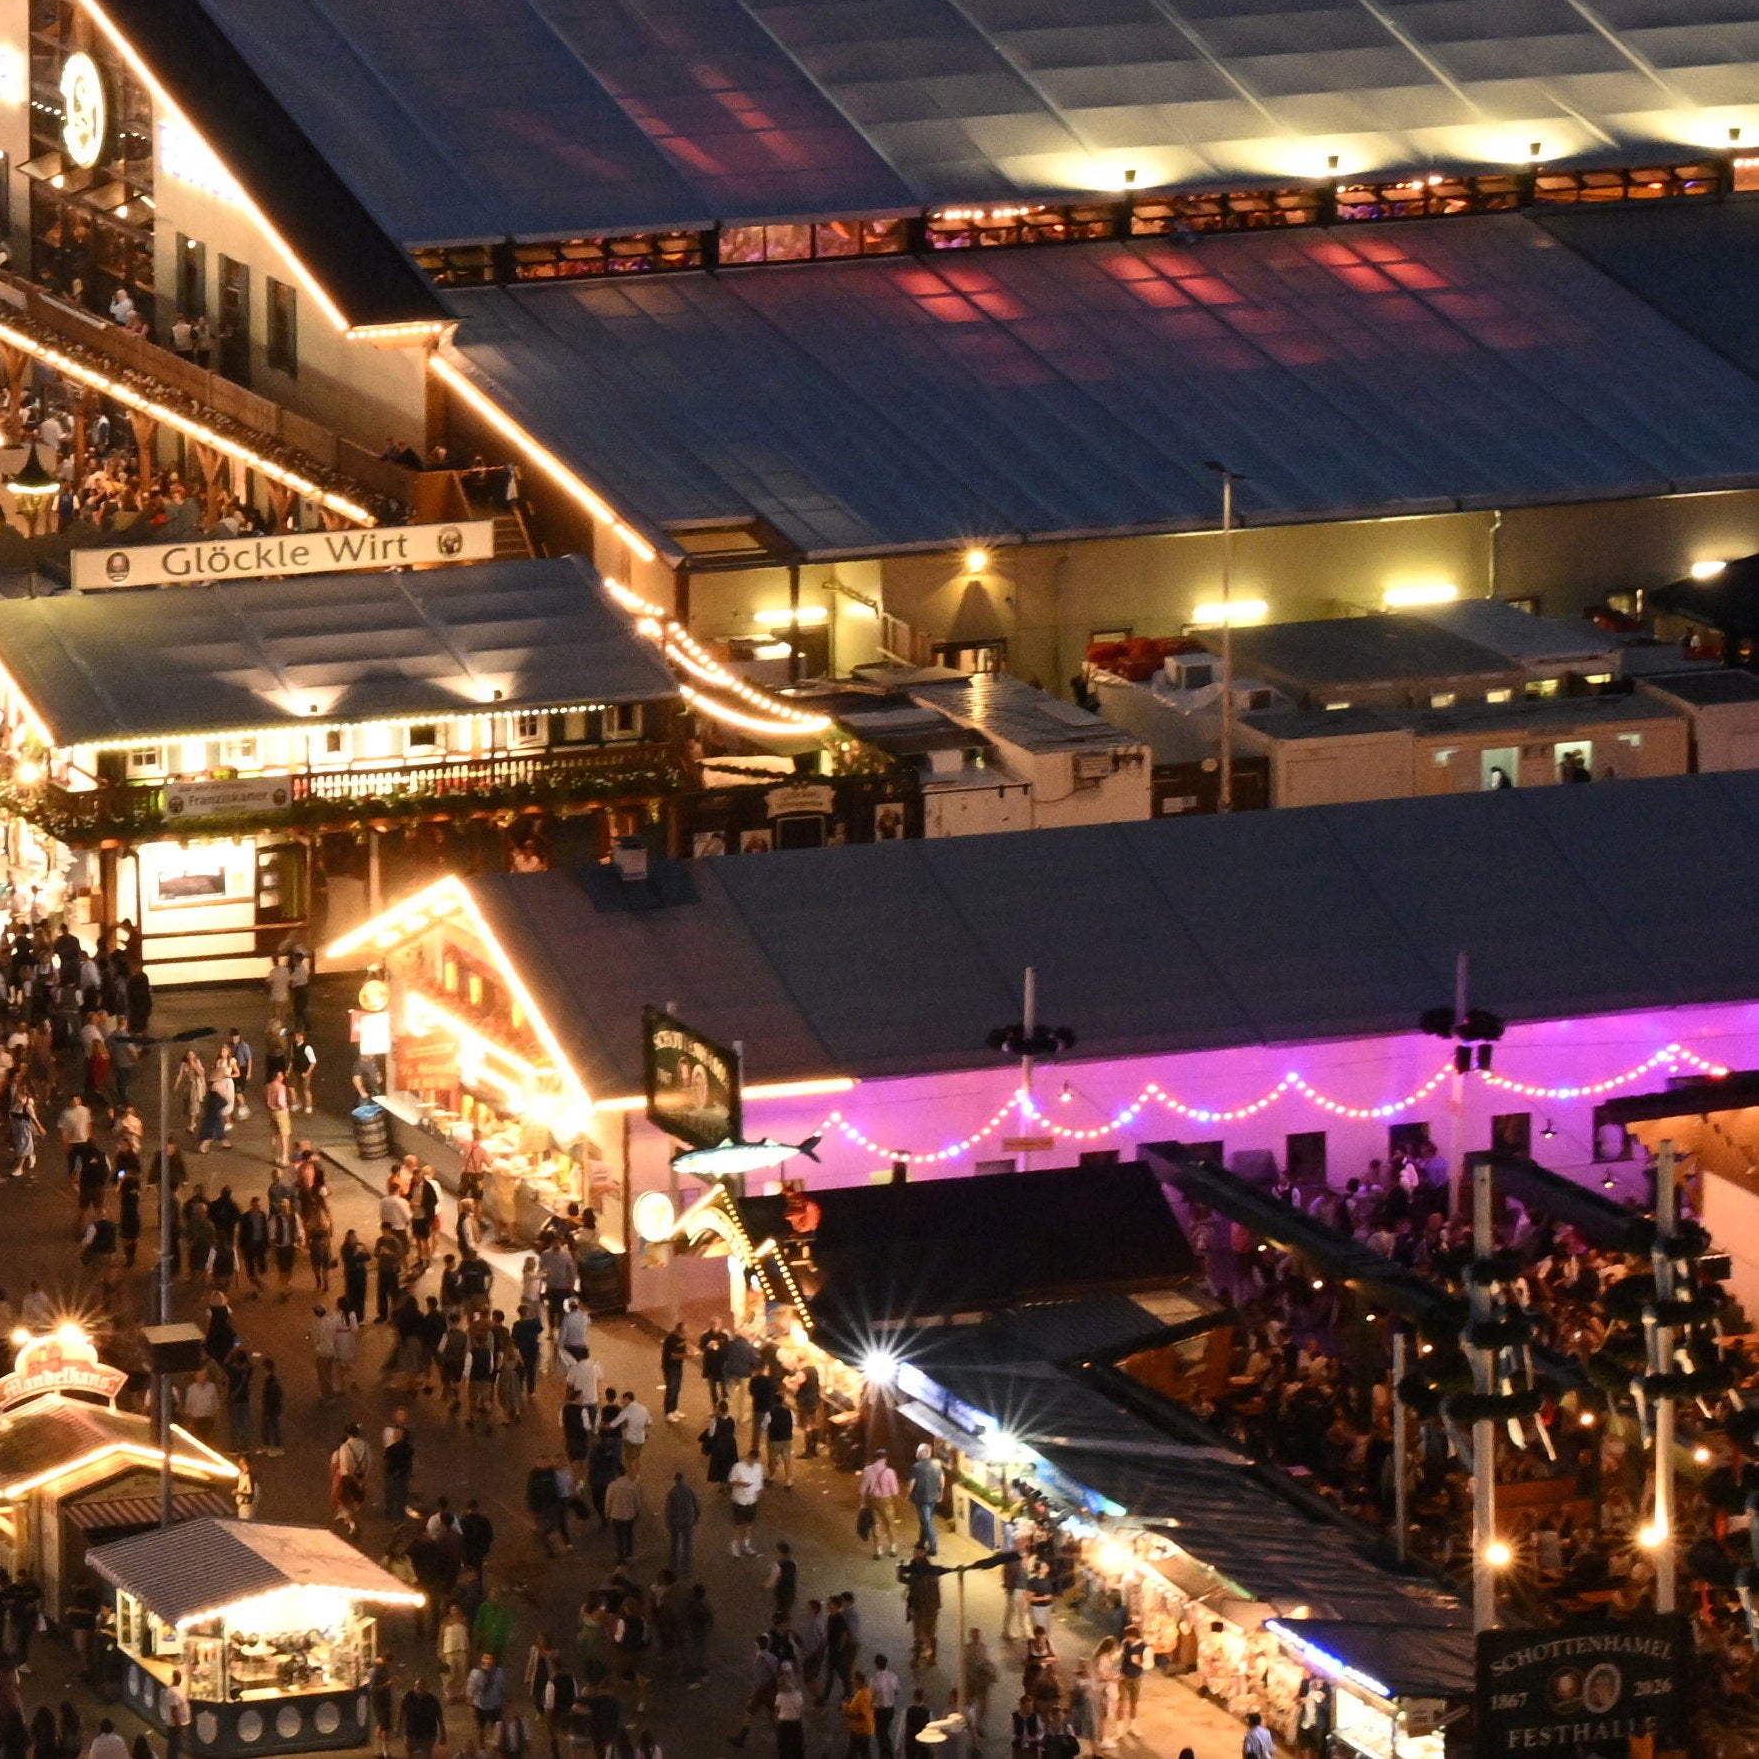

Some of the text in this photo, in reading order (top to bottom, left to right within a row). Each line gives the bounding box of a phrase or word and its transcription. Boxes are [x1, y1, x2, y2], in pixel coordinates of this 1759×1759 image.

[161, 533, 408, 577] Glöckle Wirt
[1488, 1633, 1676, 1678] SCHOTTENHAMEL
